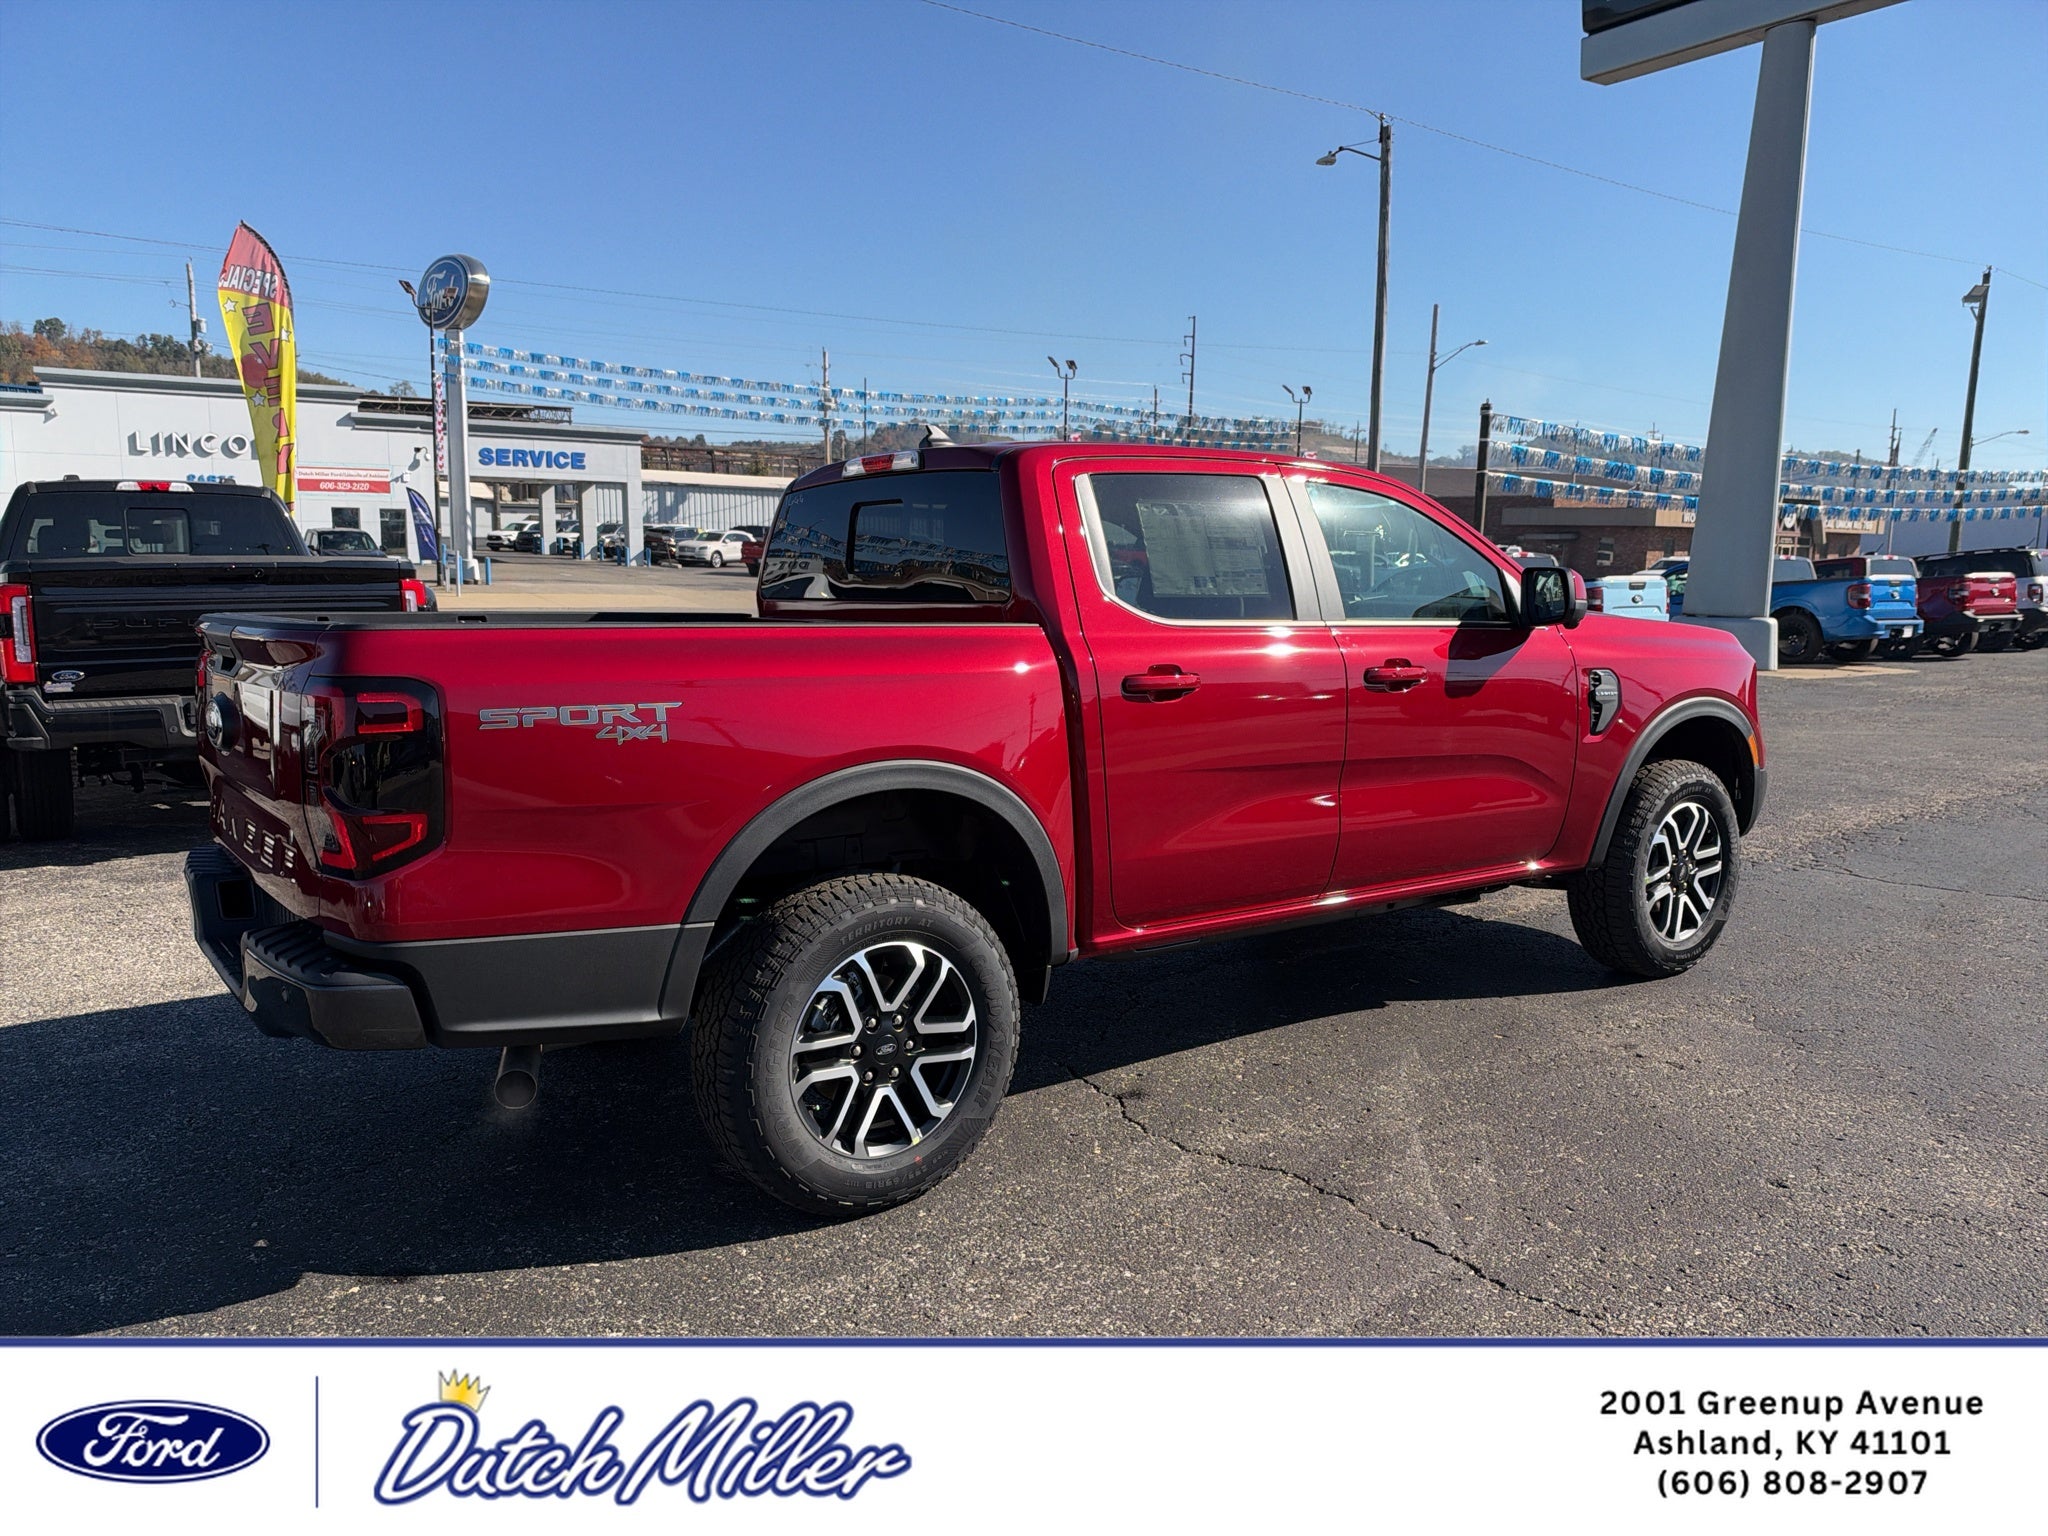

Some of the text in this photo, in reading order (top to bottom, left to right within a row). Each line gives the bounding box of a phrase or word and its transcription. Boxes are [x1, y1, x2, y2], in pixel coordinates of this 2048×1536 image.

[135, 431, 249, 454] LINCO
[479, 447, 586, 470] SERVICE
[479, 702, 683, 730] SPORT
[595, 723, 668, 746] 4x4
[841, 916, 911, 945] TERRITORY
